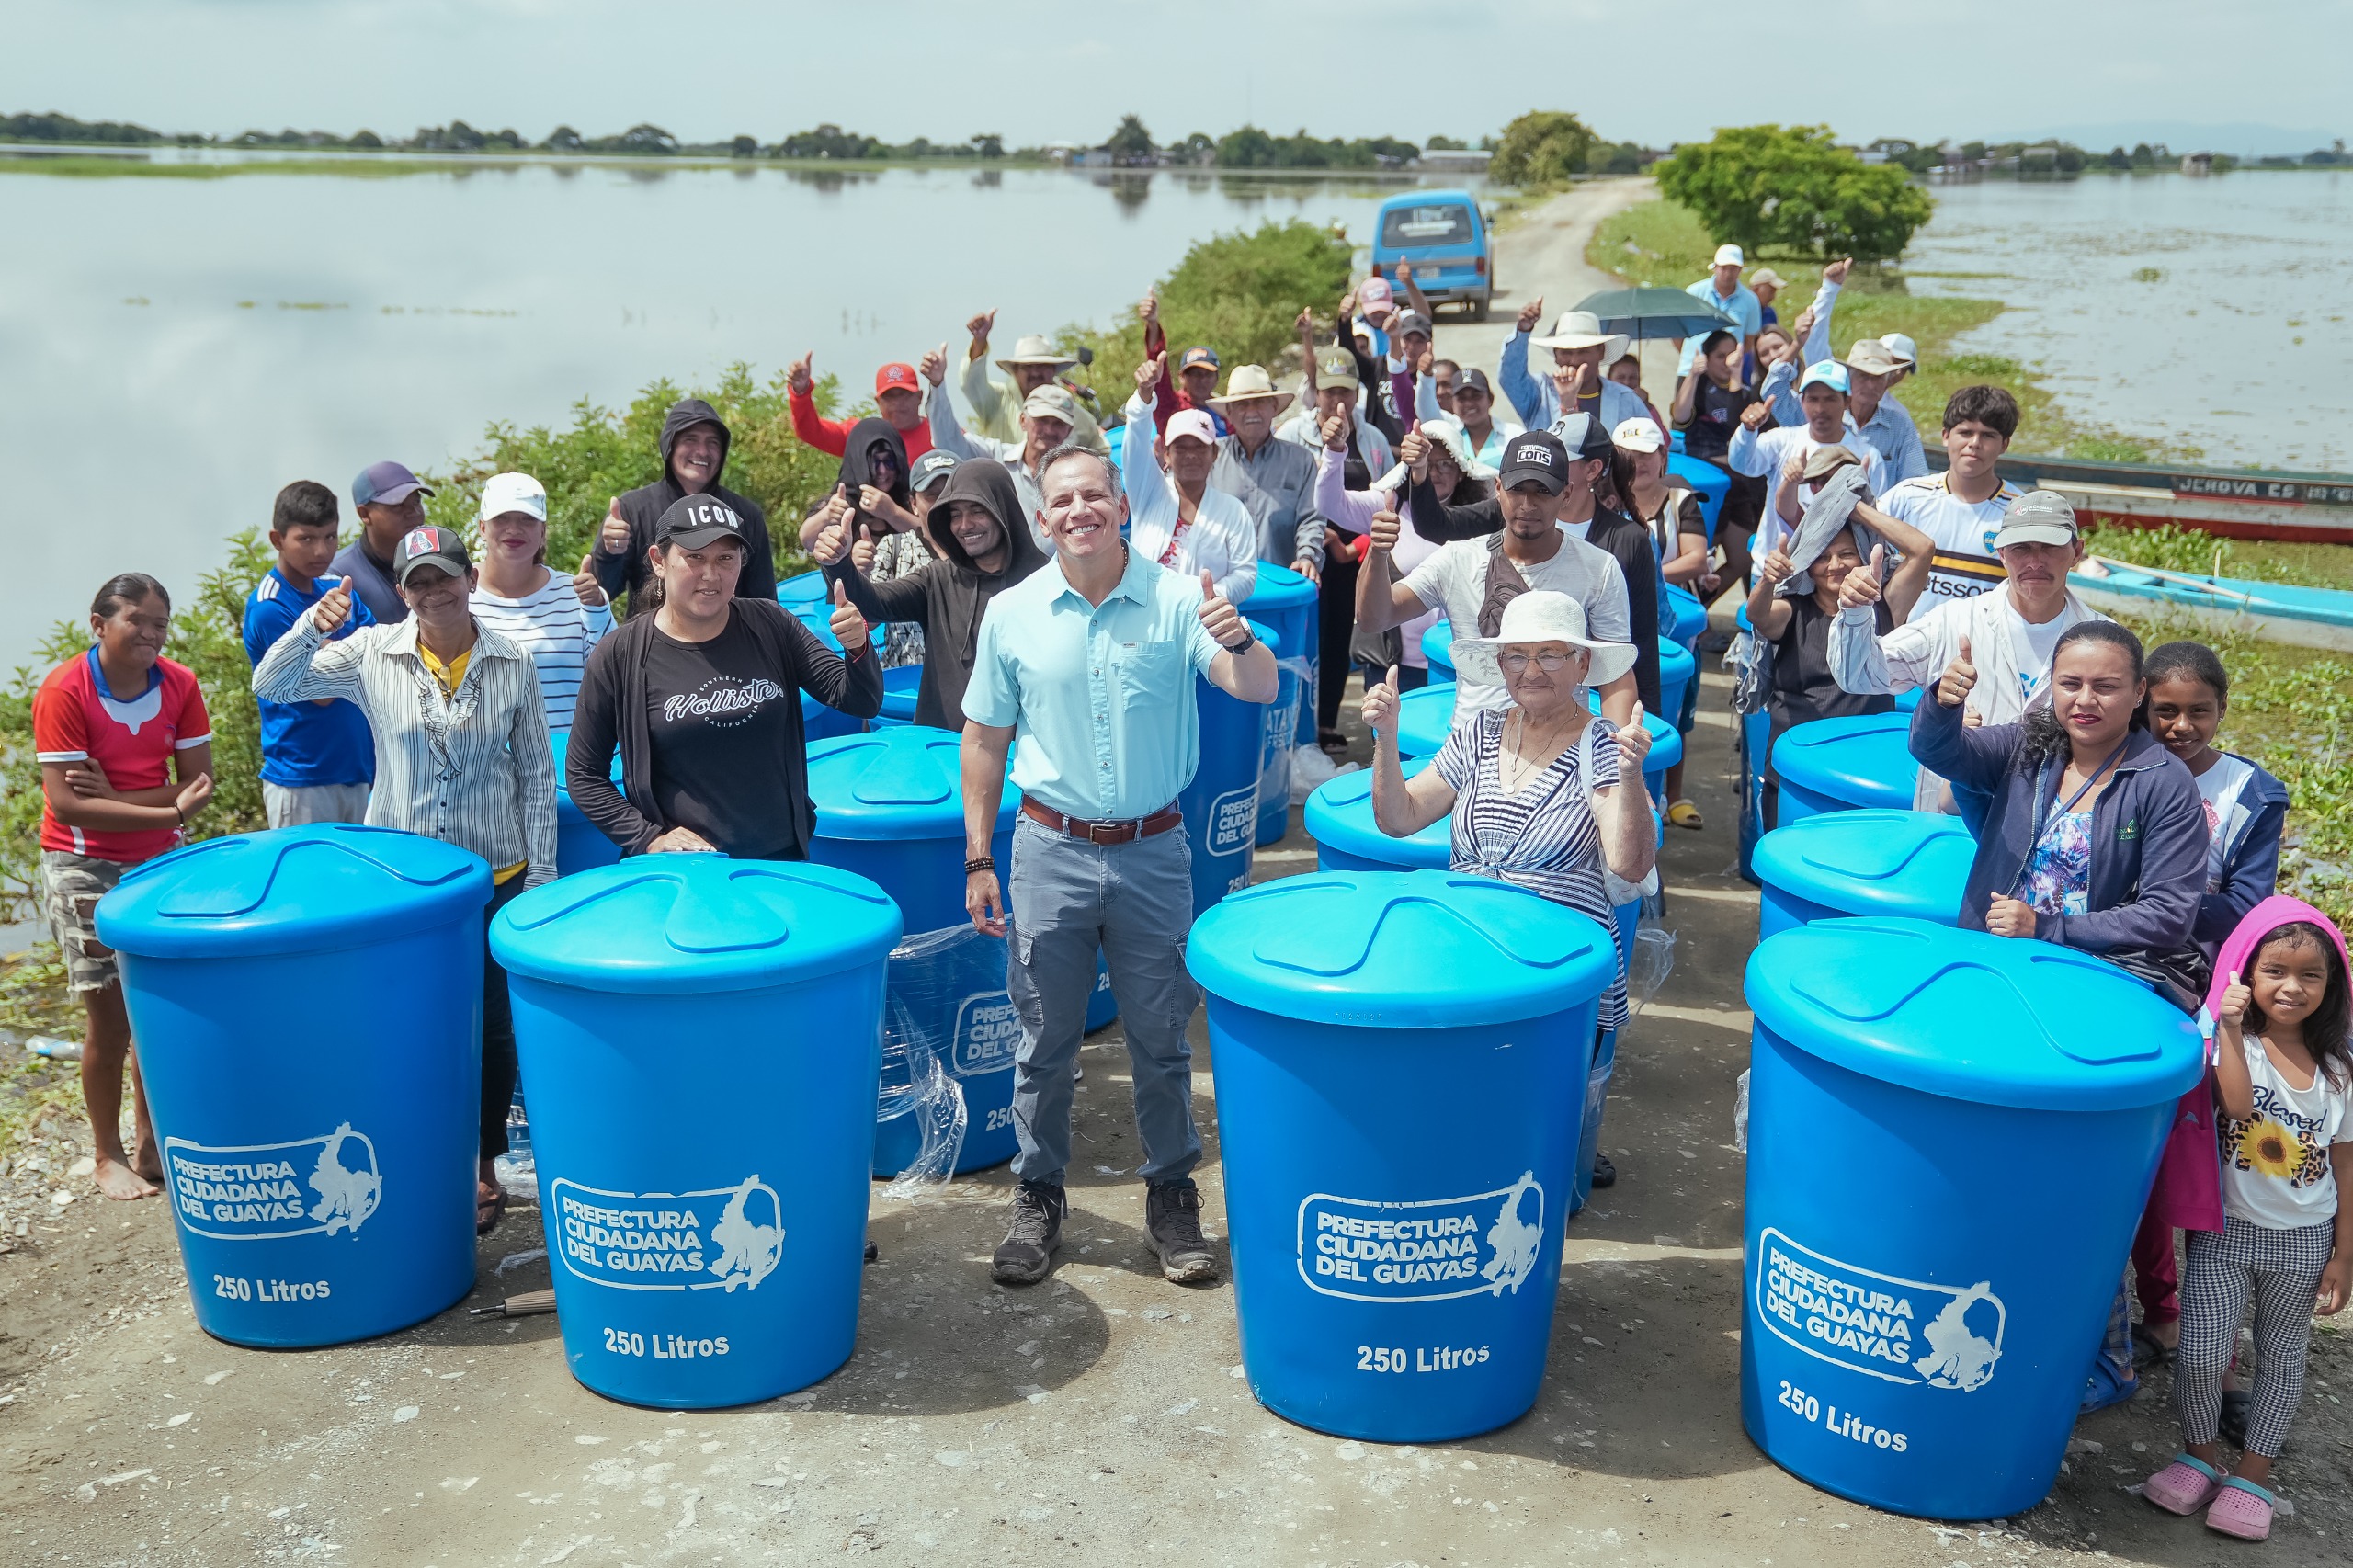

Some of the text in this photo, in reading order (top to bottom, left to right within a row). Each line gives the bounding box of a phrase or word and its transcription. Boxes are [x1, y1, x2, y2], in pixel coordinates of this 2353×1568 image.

[688, 505, 739, 529] ICON
[699, 676, 743, 692] SOUTHERN
[664, 678, 784, 722] Hollister
[704, 704, 759, 728] CALIFORNIA
[1216, 828, 1239, 845] DEL
[1097, 971, 1110, 992] 25
[972, 1003, 1020, 1025] PREFE
[970, 1020, 1024, 1042] CIUDA
[967, 1040, 1003, 1061] DEL
[172, 1154, 297, 1182] PREFECTURA
[176, 1176, 301, 1202] CIUDADANA
[180, 1194, 304, 1223] DEL GUAYAS
[563, 1196, 700, 1229] PREFECTURA
[564, 1217, 703, 1251] CIUDADANA
[1317, 1211, 1479, 1240] PREFECTURA
[567, 1236, 704, 1272] DEL GUAYAS
[1316, 1233, 1479, 1262] CIUDADANA
[1316, 1255, 1478, 1284] DEL GUAYAS
[1770, 1246, 1915, 1320] PREFECTURA
[213, 1274, 331, 1302] 250 Litros
[1768, 1268, 1912, 1342] CIUDADANA
[1766, 1289, 1910, 1365] DEL GUAYAS
[603, 1327, 730, 1358] 250 Litros
[1357, 1345, 1490, 1373] 250 Litros
[1778, 1379, 1908, 1452] 250 Litros
